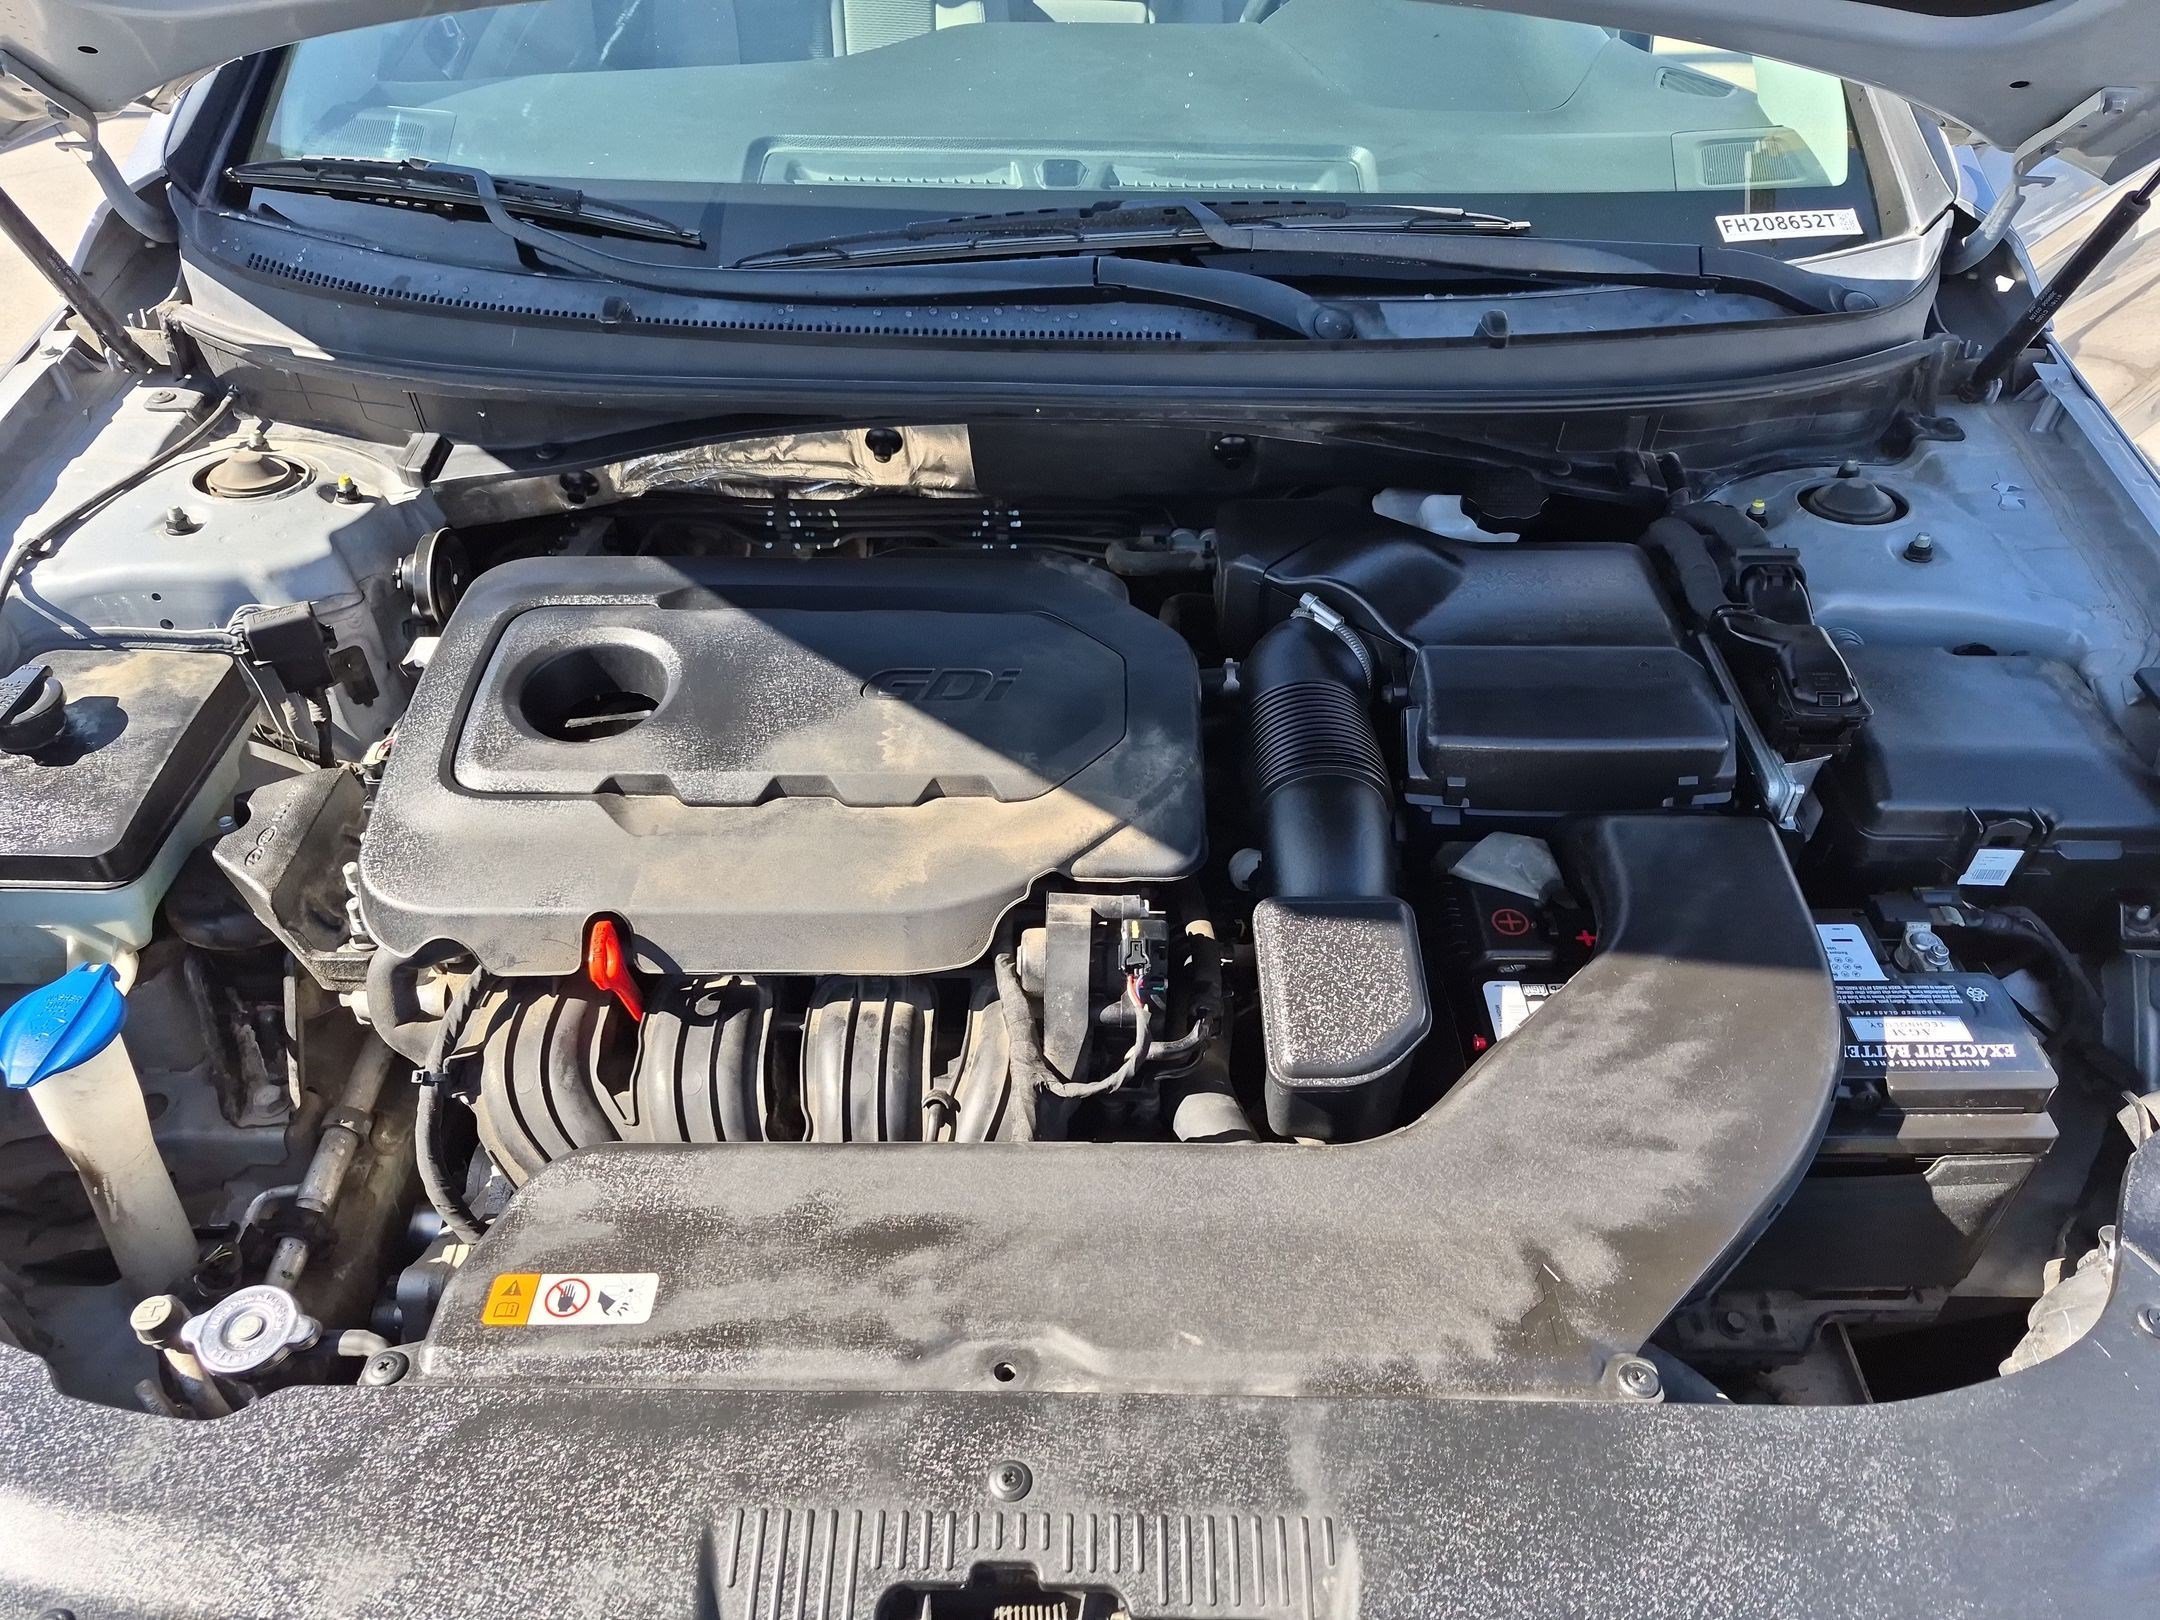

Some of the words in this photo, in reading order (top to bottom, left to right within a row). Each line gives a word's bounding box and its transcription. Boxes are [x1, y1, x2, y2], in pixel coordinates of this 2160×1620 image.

[1722, 213, 1836, 234] FH208652T
[859, 667, 1022, 701] GDi
[1844, 1043, 1909, 1058] BATTE
[1914, 1043, 2017, 1058] EXACT-FIT
